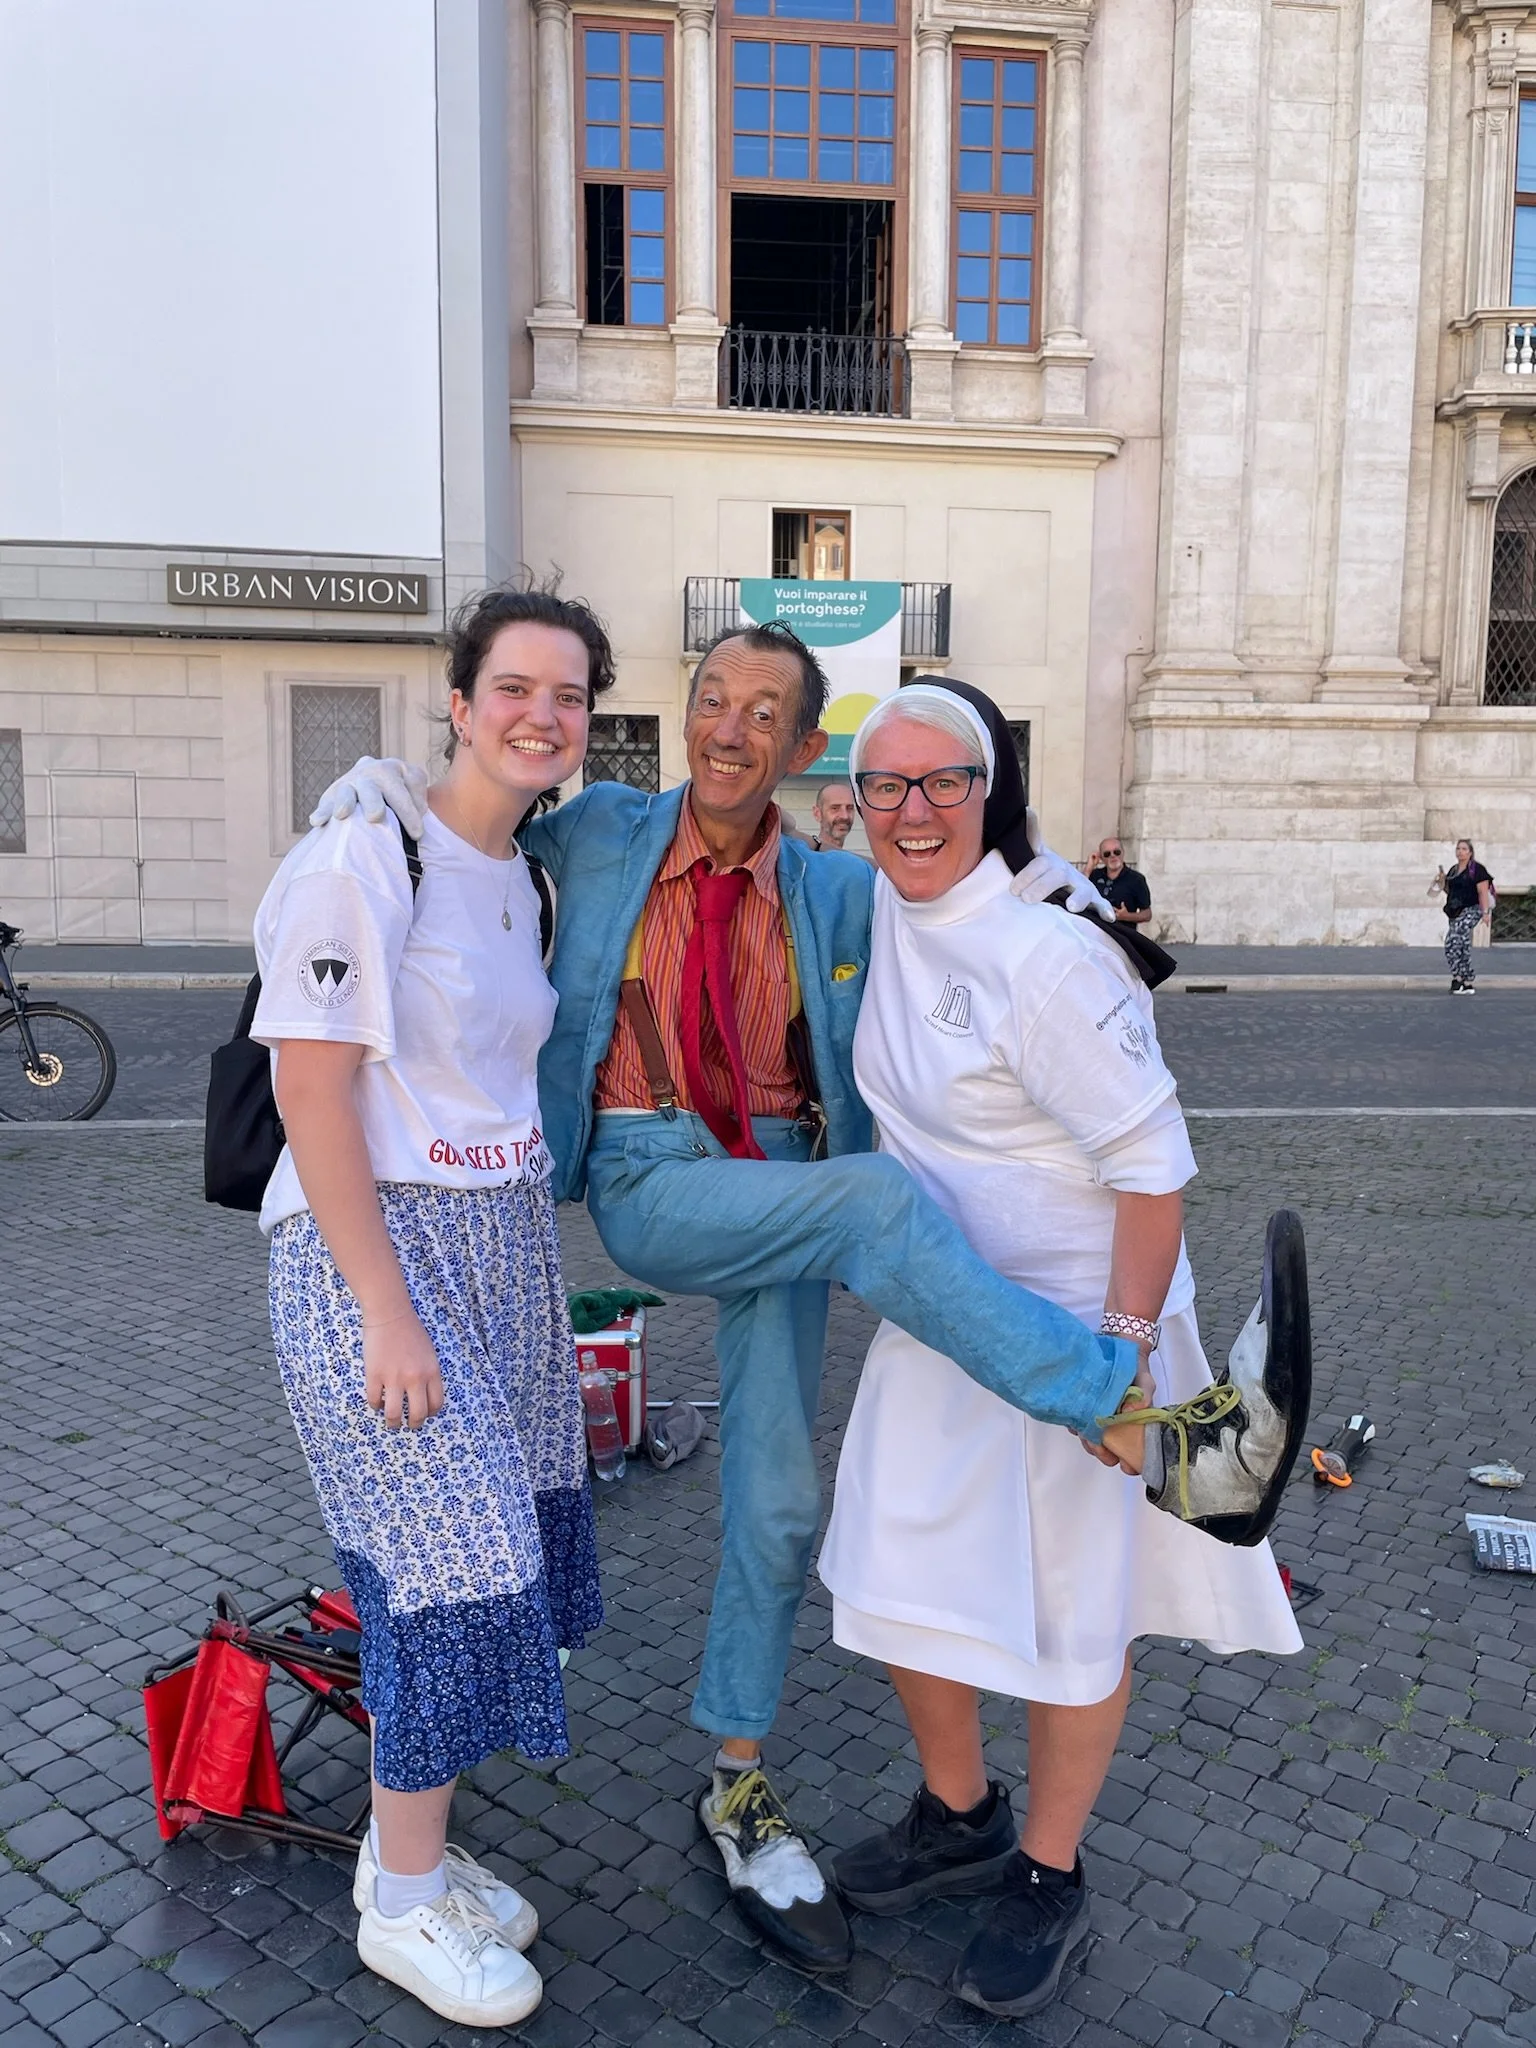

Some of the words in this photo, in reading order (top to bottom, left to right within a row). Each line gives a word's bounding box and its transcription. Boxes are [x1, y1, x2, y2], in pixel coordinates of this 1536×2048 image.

[175, 571, 292, 600] URBAN
[305, 576, 419, 604] VISION
[774, 588, 801, 600] Vuoi
[804, 588, 857, 602] imparare
[860, 590, 868, 601] il
[776, 602, 866, 617] portoghese?
[302, 941, 336, 967] DOMINICAN
[337, 944, 359, 972] SISTERS
[465, 1144, 507, 1170] SEES
[1504, 1543, 1517, 1570] Caino
